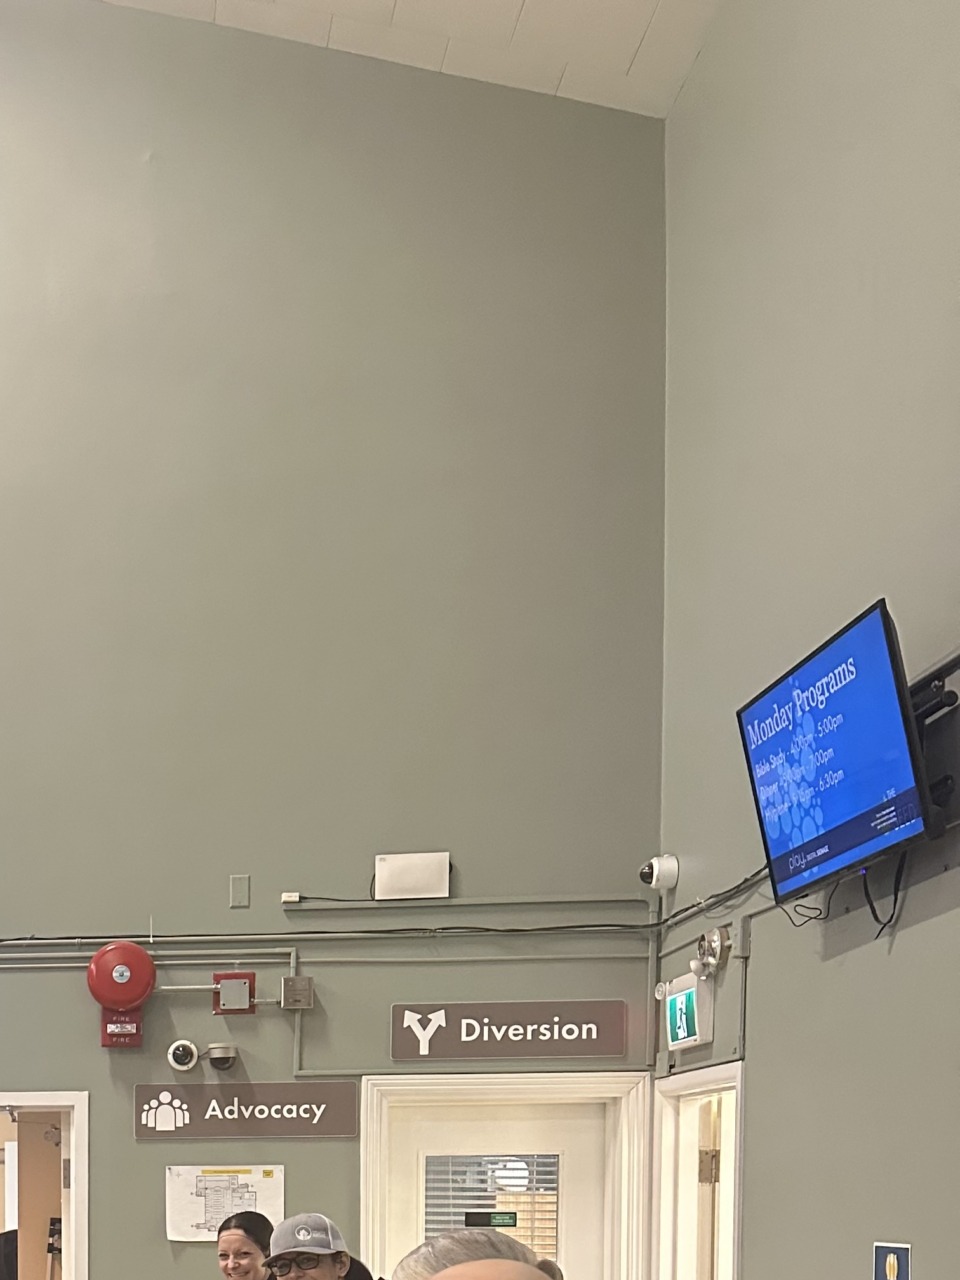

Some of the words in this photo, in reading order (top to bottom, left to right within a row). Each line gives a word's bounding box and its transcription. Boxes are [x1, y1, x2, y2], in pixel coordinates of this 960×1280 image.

[747, 702, 793, 749] Monday
[793, 657, 856, 716] Programs
[817, 713, 844, 738] 5:00pm
[818, 768, 845, 793] 6:30pm
[460, 1016, 598, 1042] Diversion
[204, 1096, 327, 1124] Advocacy
